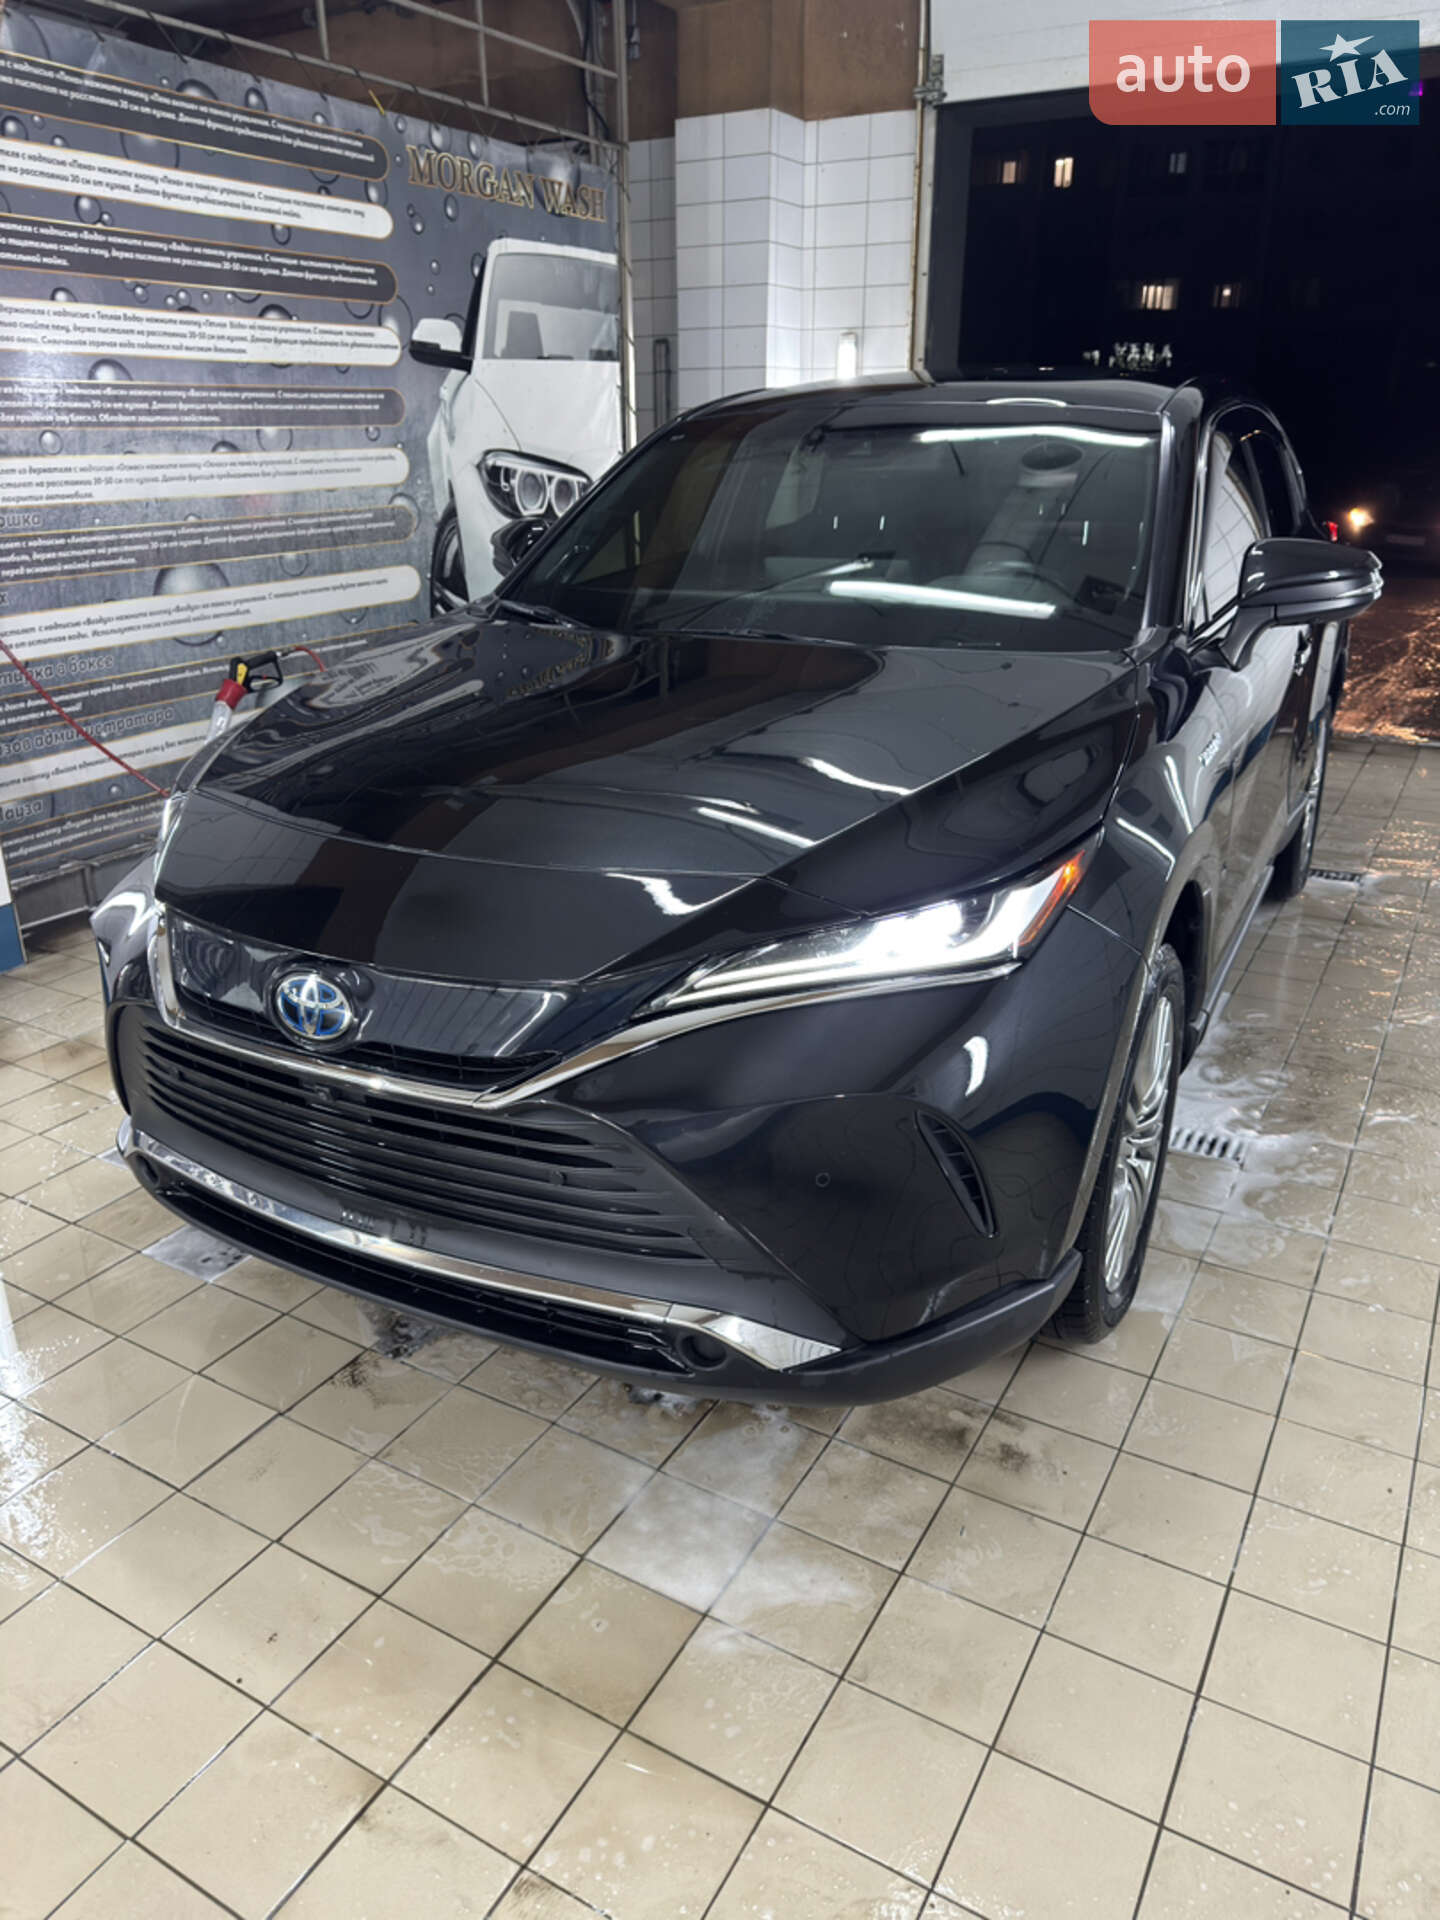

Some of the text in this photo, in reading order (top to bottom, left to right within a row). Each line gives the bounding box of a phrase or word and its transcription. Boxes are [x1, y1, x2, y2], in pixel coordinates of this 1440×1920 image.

[406, 144, 607, 223] MORGAN WASH
[34, 708, 175, 747] адмиистратора
